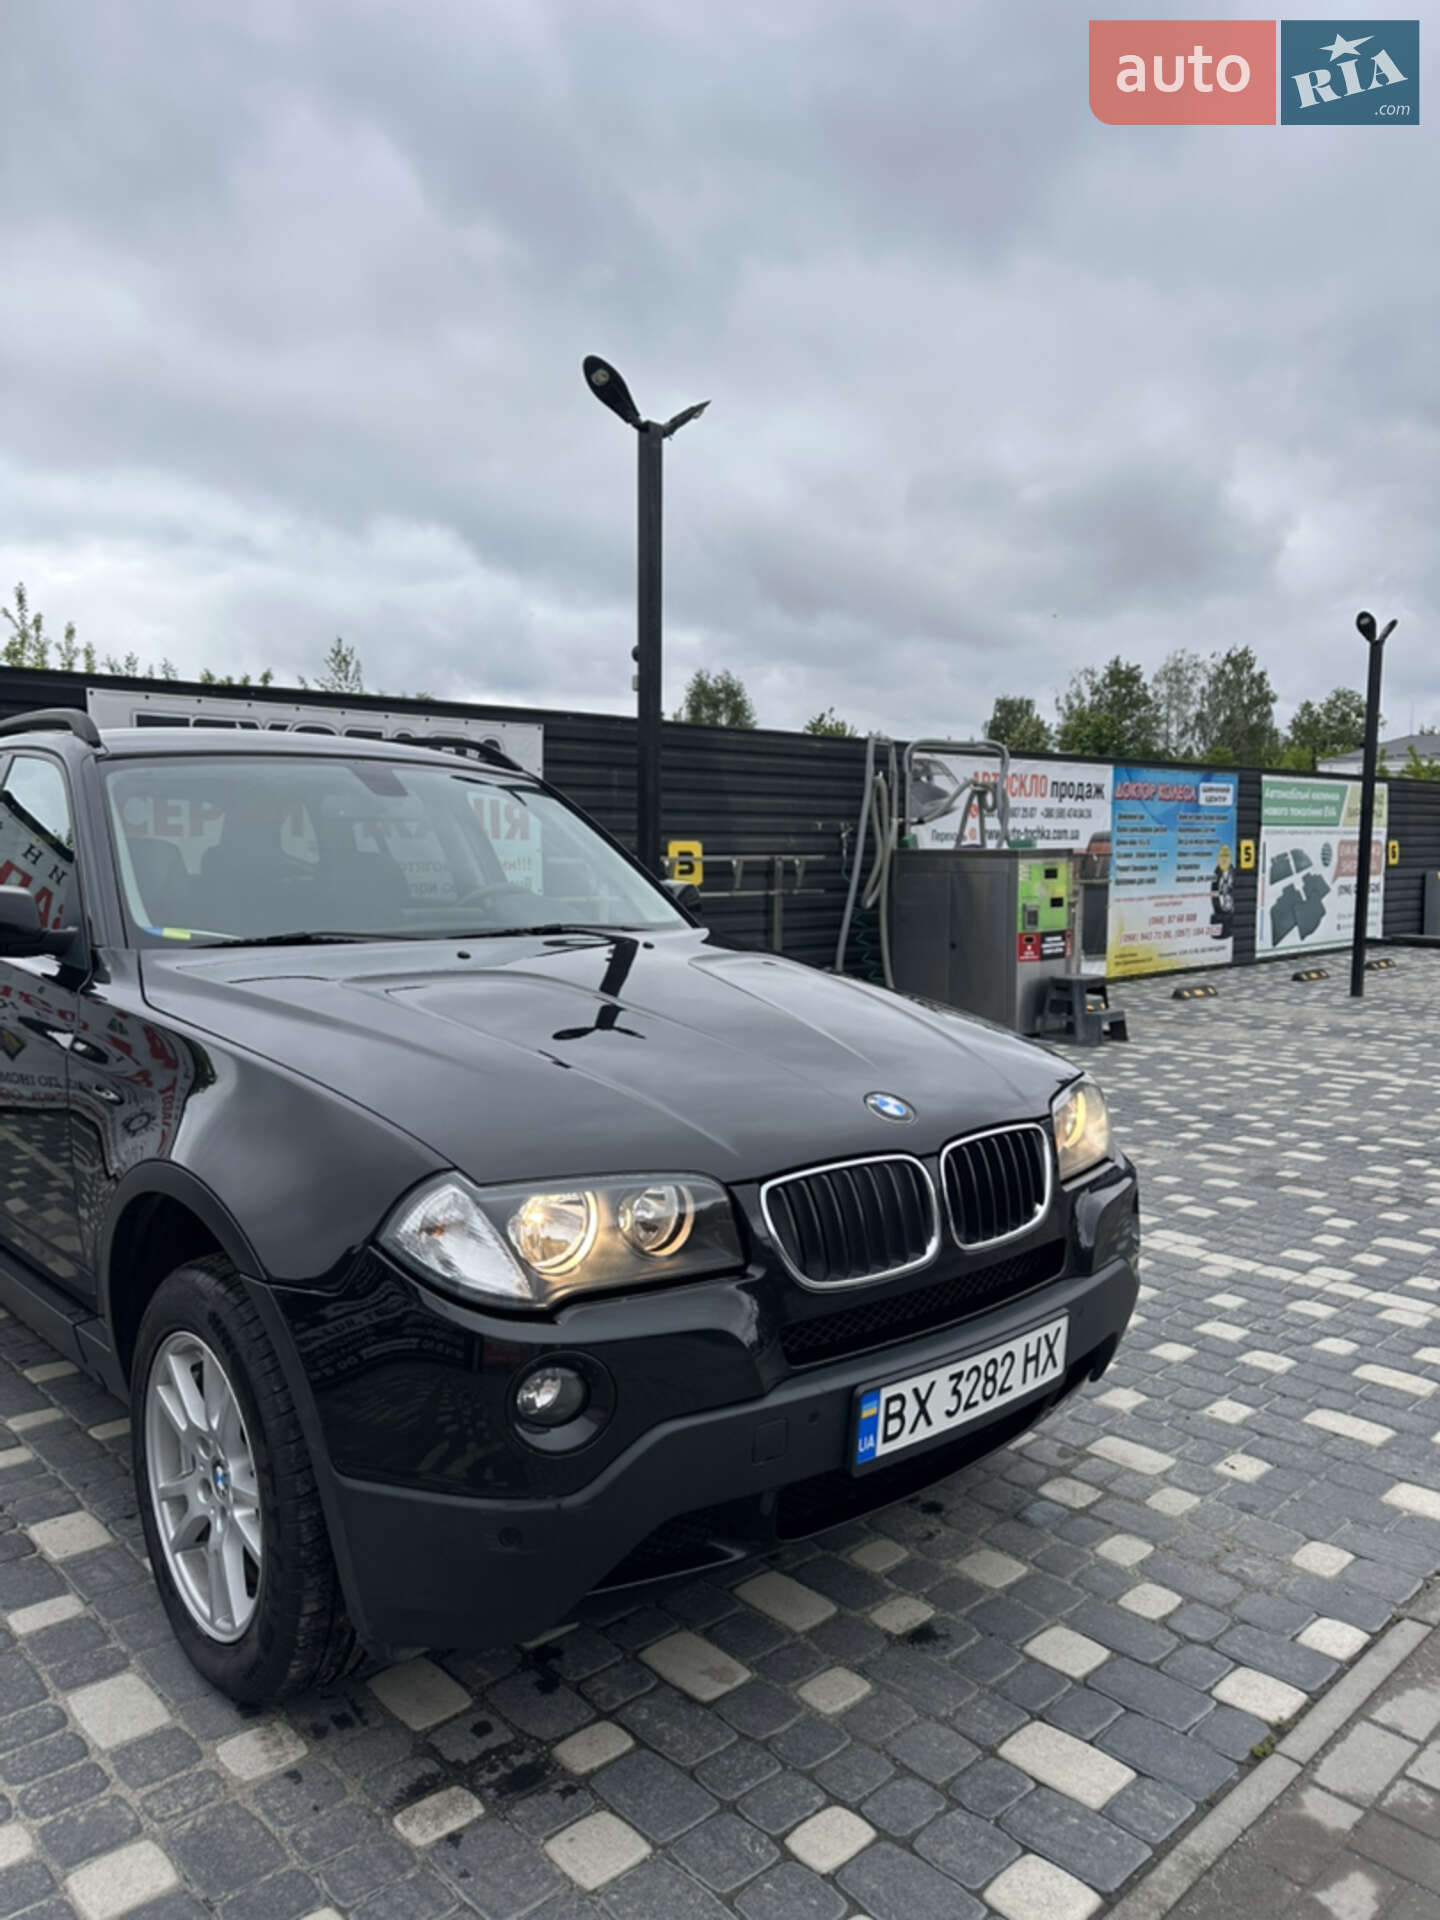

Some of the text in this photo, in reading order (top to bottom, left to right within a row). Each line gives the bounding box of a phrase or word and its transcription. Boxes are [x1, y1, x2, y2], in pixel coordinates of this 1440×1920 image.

[1050, 779, 1105, 801] продаж
[881, 1326, 1062, 1444] BX 3282 HX
[857, 1435, 875, 1452] UA
